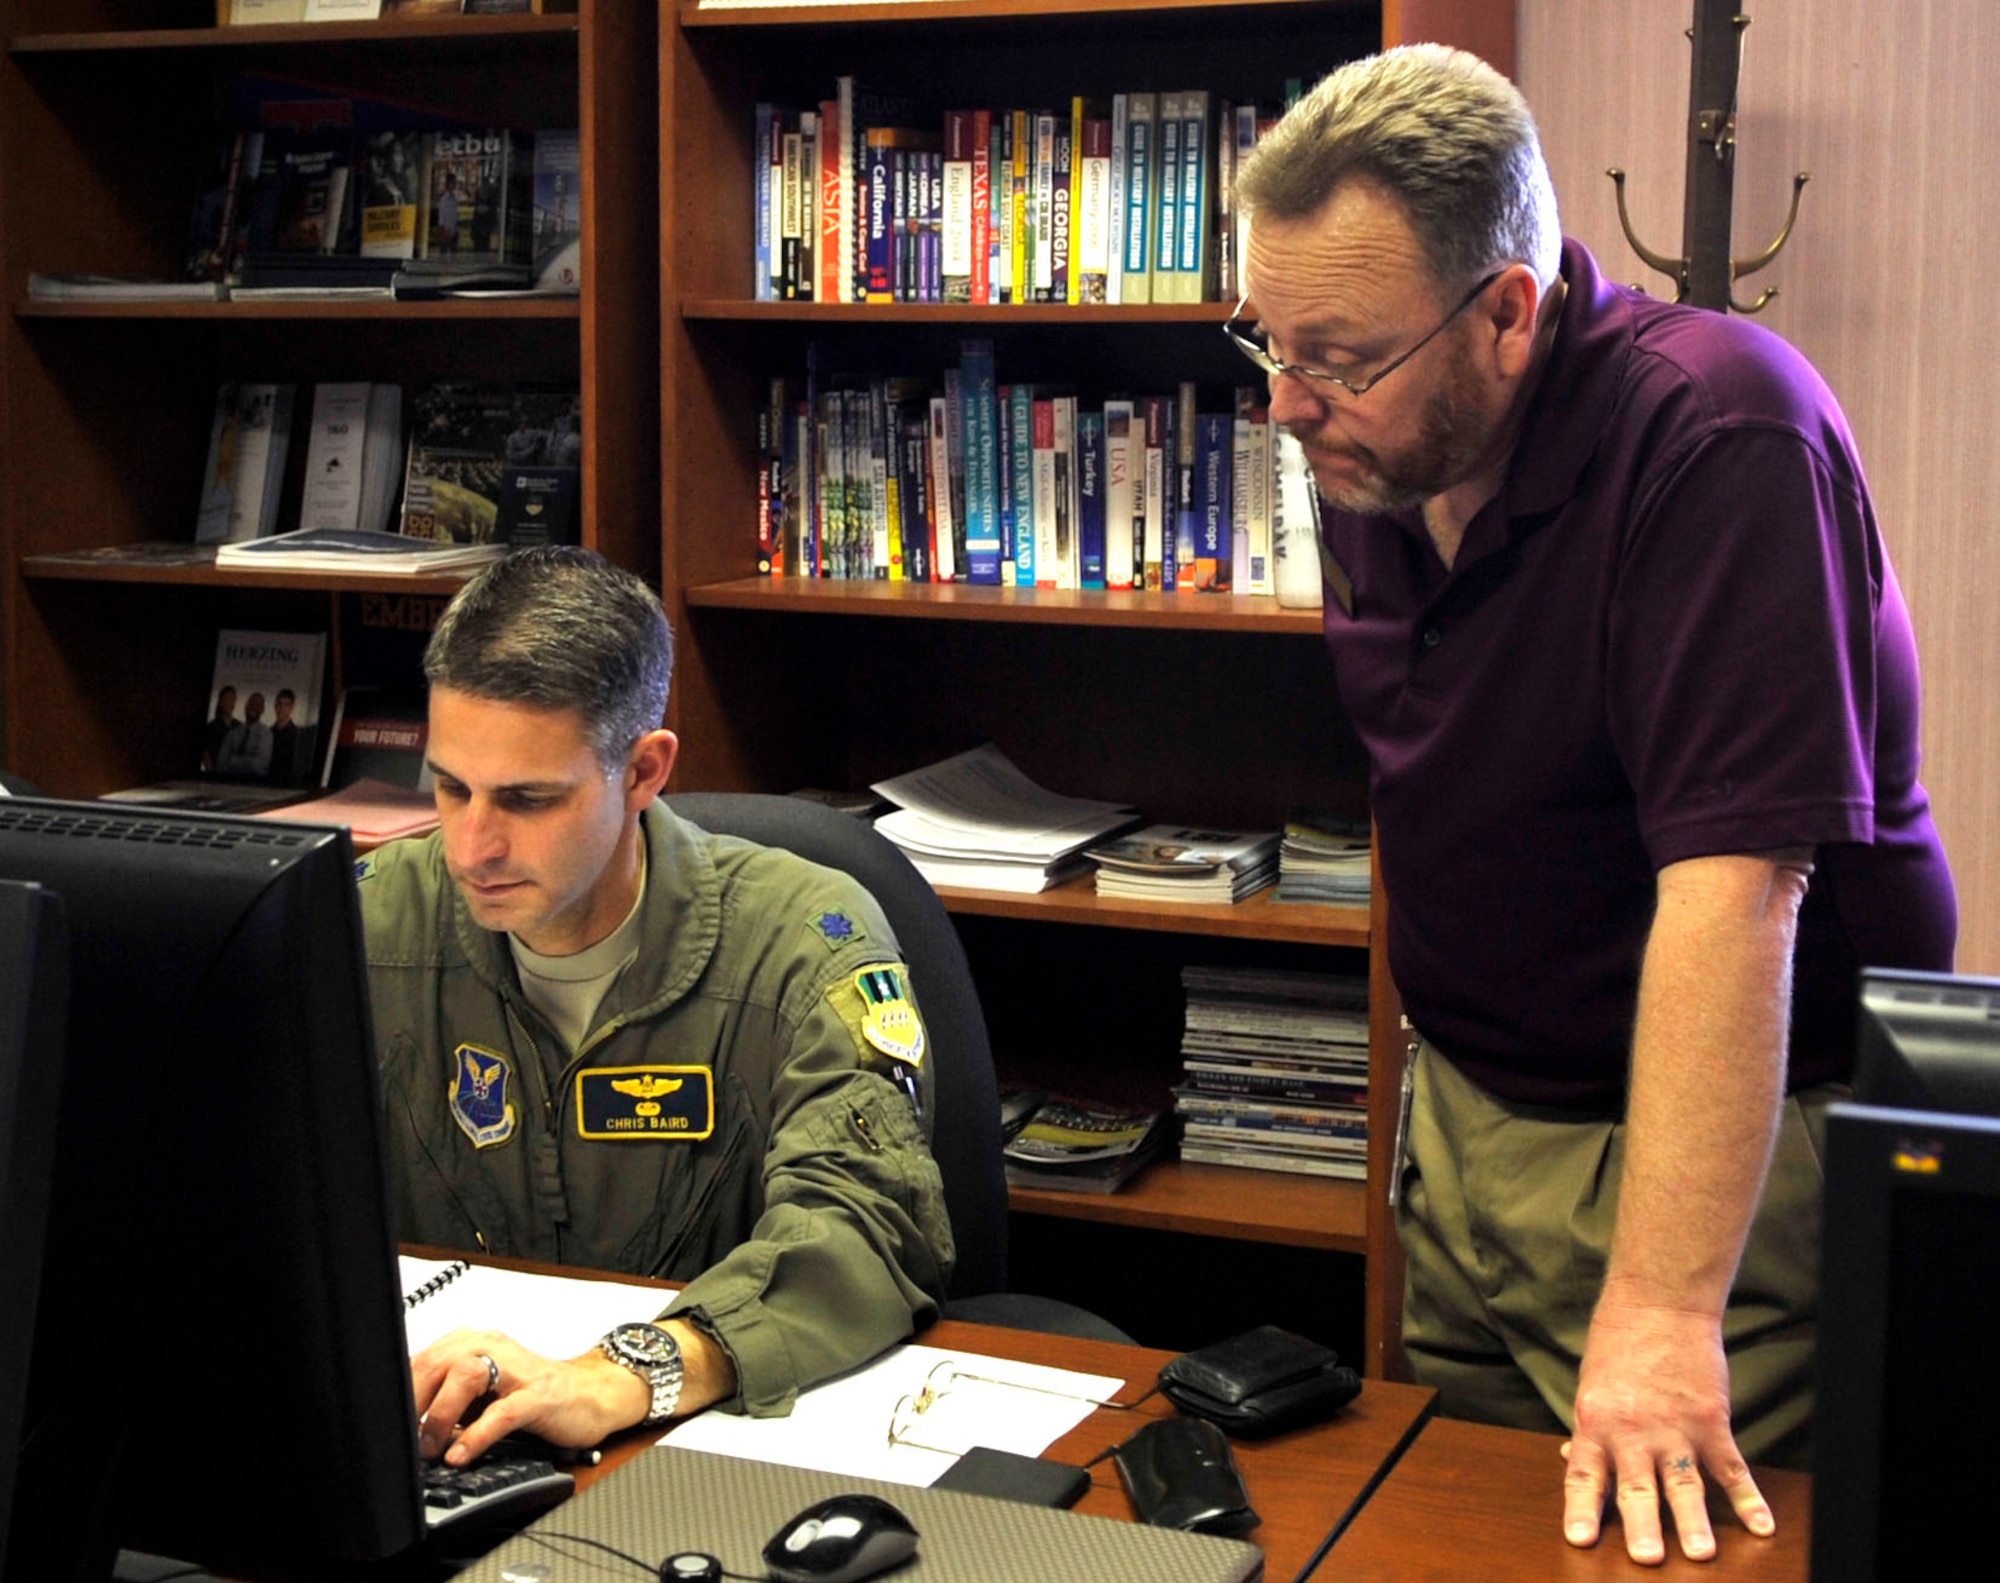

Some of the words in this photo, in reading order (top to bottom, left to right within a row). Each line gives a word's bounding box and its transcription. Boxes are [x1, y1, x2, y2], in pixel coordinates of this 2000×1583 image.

[1060, 136, 1070, 173] MOON
[1133, 125, 1145, 150] GUIDE
[1133, 153, 1144, 163] TO
[786, 139, 797, 181] AMERICAN
[974, 146, 988, 210] TEXAS
[823, 170, 841, 235] ASIA
[859, 185, 868, 217] Boston
[872, 164, 886, 239] California
[894, 171, 904, 217] BRITAIN
[908, 171, 918, 217] JAPAN
[919, 171, 929, 216] KOREA
[932, 178, 941, 209] USA
[950, 167, 965, 223] England
[1088, 160, 1103, 218] Germany
[1131, 166, 1144, 204] MILITARY
[1163, 164, 1176, 203] MILITARY
[1185, 164, 1198, 203] MILITARY
[786, 183, 797, 233] SOUTHWEST
[859, 228, 868, 252] Cape
[1002, 223, 1012, 251] COAST
[1054, 189, 1069, 271] GEORGIA
[1130, 206, 1143, 269] INSTALLATIONS
[1161, 205, 1174, 268] INSTALLATIONS
[1183, 205, 1197, 268] INSTALLATIONS
[859, 254, 868, 272] Cod
[887, 404, 897, 424] San
[979, 378, 992, 431] SUMMER
[1013, 404, 1028, 447] GUIDE
[887, 425, 897, 476] Francisco
[1014, 448, 1028, 468] TO
[1110, 447, 1126, 486] USA
[759, 470, 769, 497] New
[873, 465, 886, 487] SAN
[979, 434, 994, 532] OPPORTUNITIES
[1015, 470, 1029, 501] NEW
[1082, 450, 1097, 496] Turkey
[1149, 452, 1160, 497] Virginia
[1207, 450, 1220, 503] Western
[1234, 449, 1251, 534] WILLIAMSBURG
[1252, 445, 1264, 521] WISCONSIN
[873, 488, 886, 532] ANTONIO
[1132, 479, 1143, 511] UTAH
[759, 499, 770, 541] Mexico
[1016, 505, 1031, 570] ENGLAND
[1205, 505, 1220, 550] Europe
[225, 644, 299, 664] HERZING
[354, 730, 378, 744] YOUR
[606, 1117, 645, 1129] CHRIS
[650, 1116, 689, 1129] BAIRD
